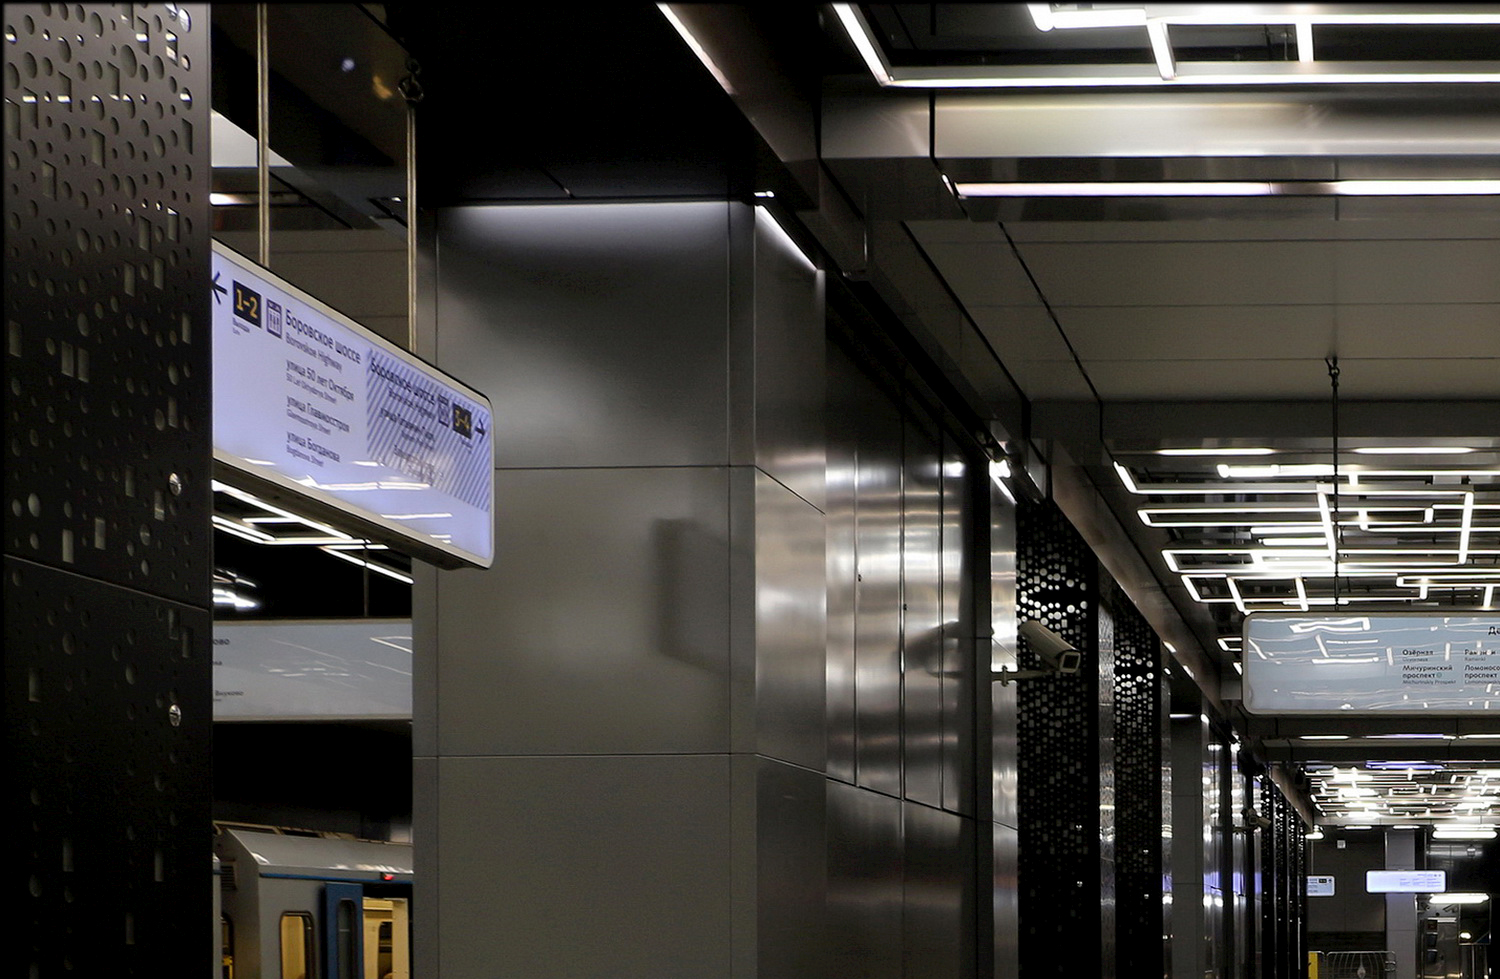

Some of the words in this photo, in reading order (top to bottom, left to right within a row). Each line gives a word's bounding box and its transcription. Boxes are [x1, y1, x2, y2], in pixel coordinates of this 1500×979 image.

[236, 289, 258, 319] 1-2
[286, 308, 334, 350] Боровское
[335, 341, 361, 364] шоссе
[317, 350, 342, 374] Highway
[287, 360, 306, 377] улица
[306, 366, 316, 381] 50
[316, 375, 327, 387] лет
[328, 379, 354, 400] Октября
[287, 395, 306, 412] улица
[287, 431, 306, 447] улица
[307, 437, 340, 462] Богданова
[1402, 648, 1434, 657] Озёрная
